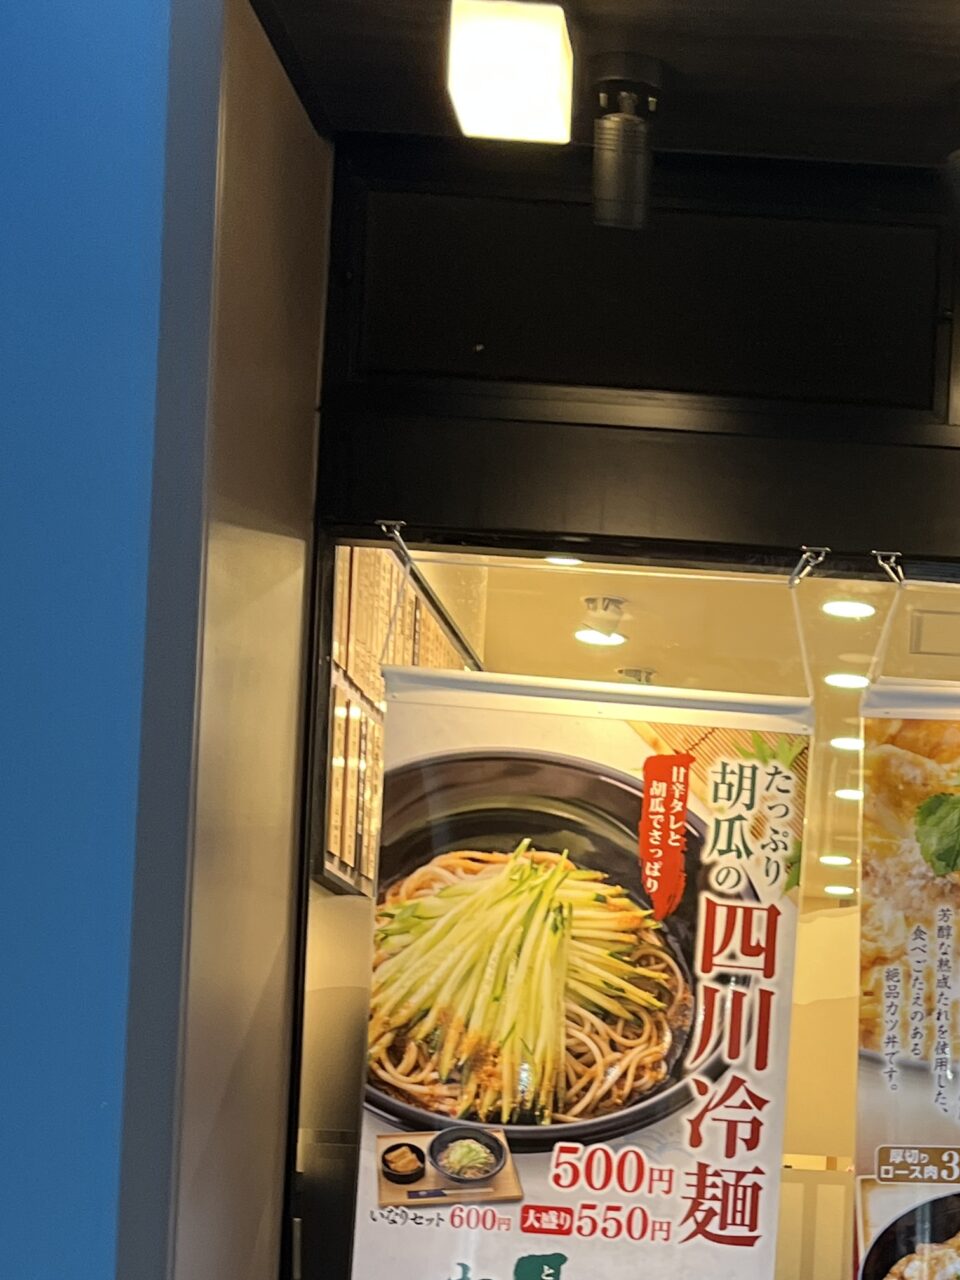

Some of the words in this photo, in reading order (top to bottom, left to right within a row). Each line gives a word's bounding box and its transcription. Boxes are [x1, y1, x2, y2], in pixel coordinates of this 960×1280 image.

[645, 780, 668, 893] 胡瓜でさっぱり
[667, 766, 688, 847] 甘辛タレと
[761, 765, 793, 886] たっぷり
[883, 968, 901, 1091] 絶品カツ丼です。
[910, 925, 927, 1057] 食べごたえのある
[370, 1205, 445, 1229] いなりセット
[450, 1205, 511, 1231] 600円
[576, 1203, 672, 1242] 550円
[552, 1144, 675, 1195] 500円
